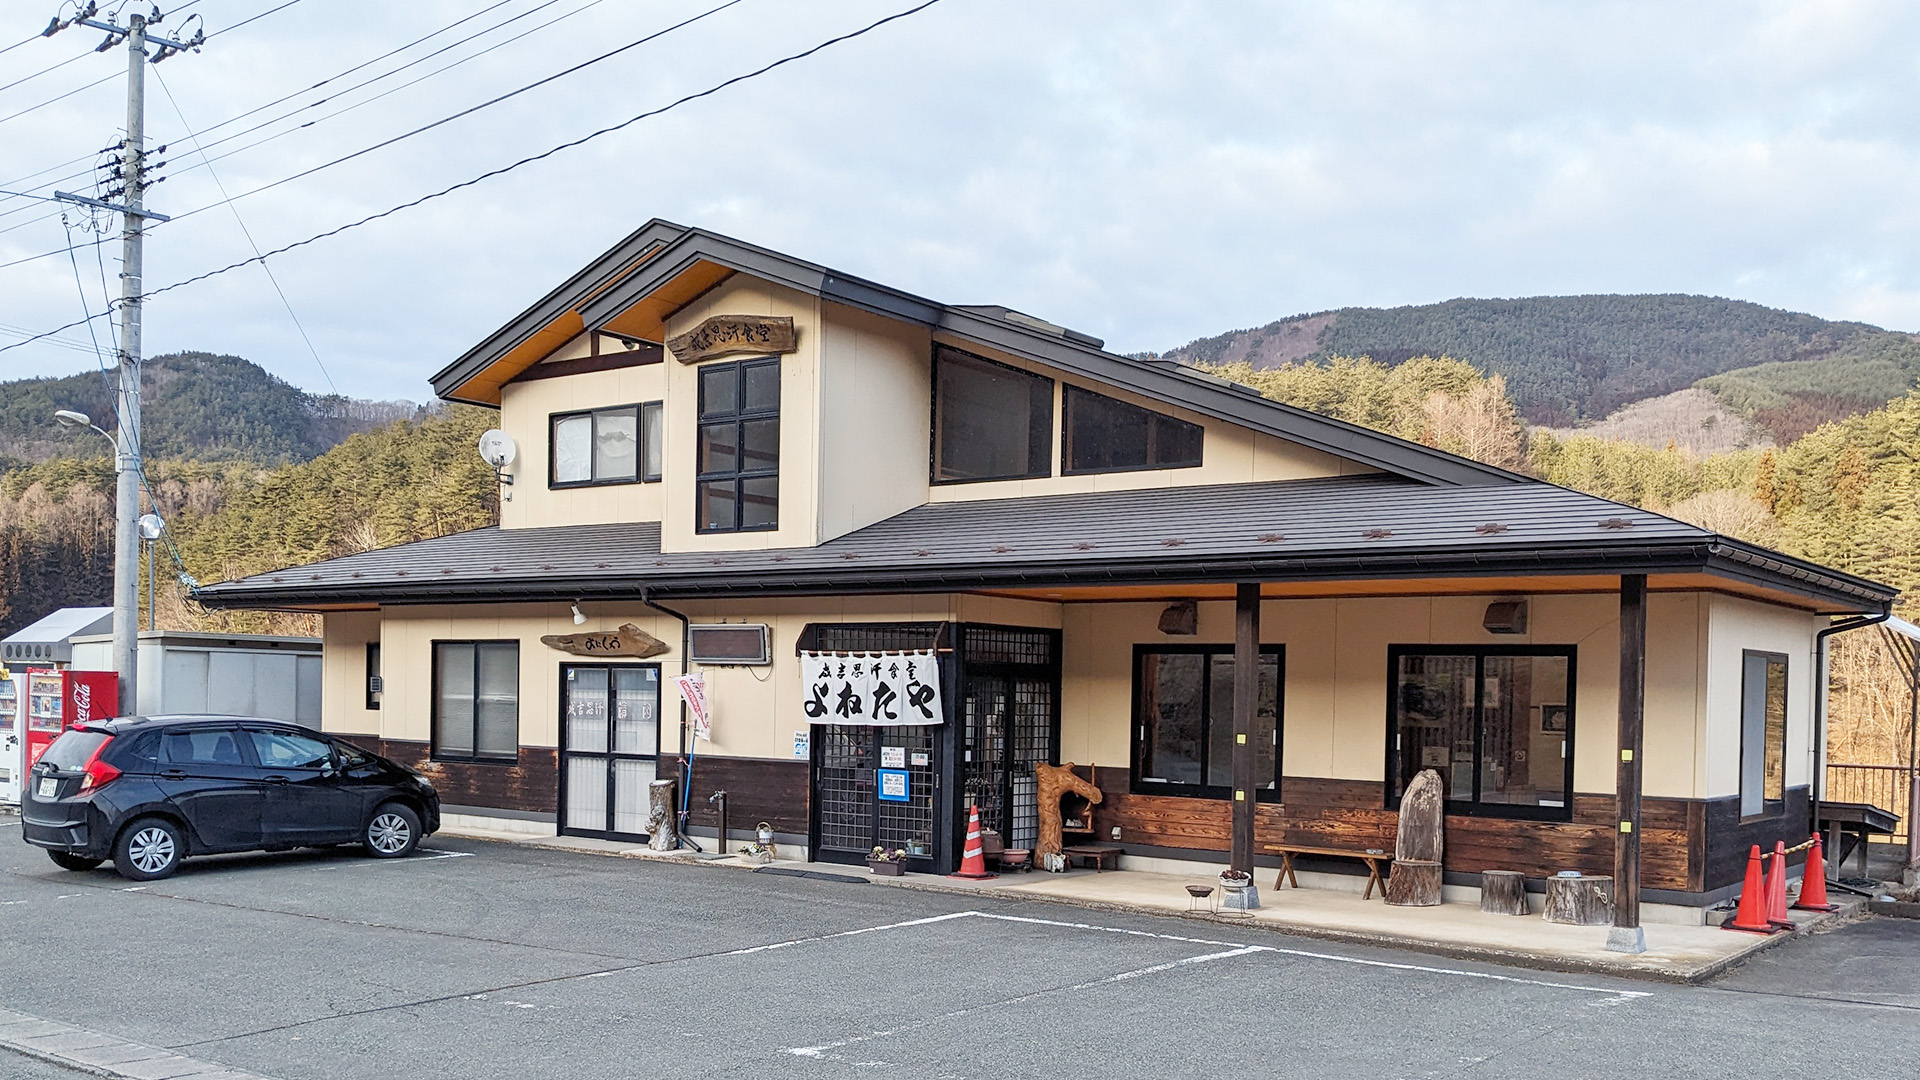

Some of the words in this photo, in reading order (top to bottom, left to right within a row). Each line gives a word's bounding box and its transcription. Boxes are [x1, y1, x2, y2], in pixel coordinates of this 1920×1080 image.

[818, 660, 917, 680] 成吉思汗食堂
[804, 680, 936, 720] よねたや
